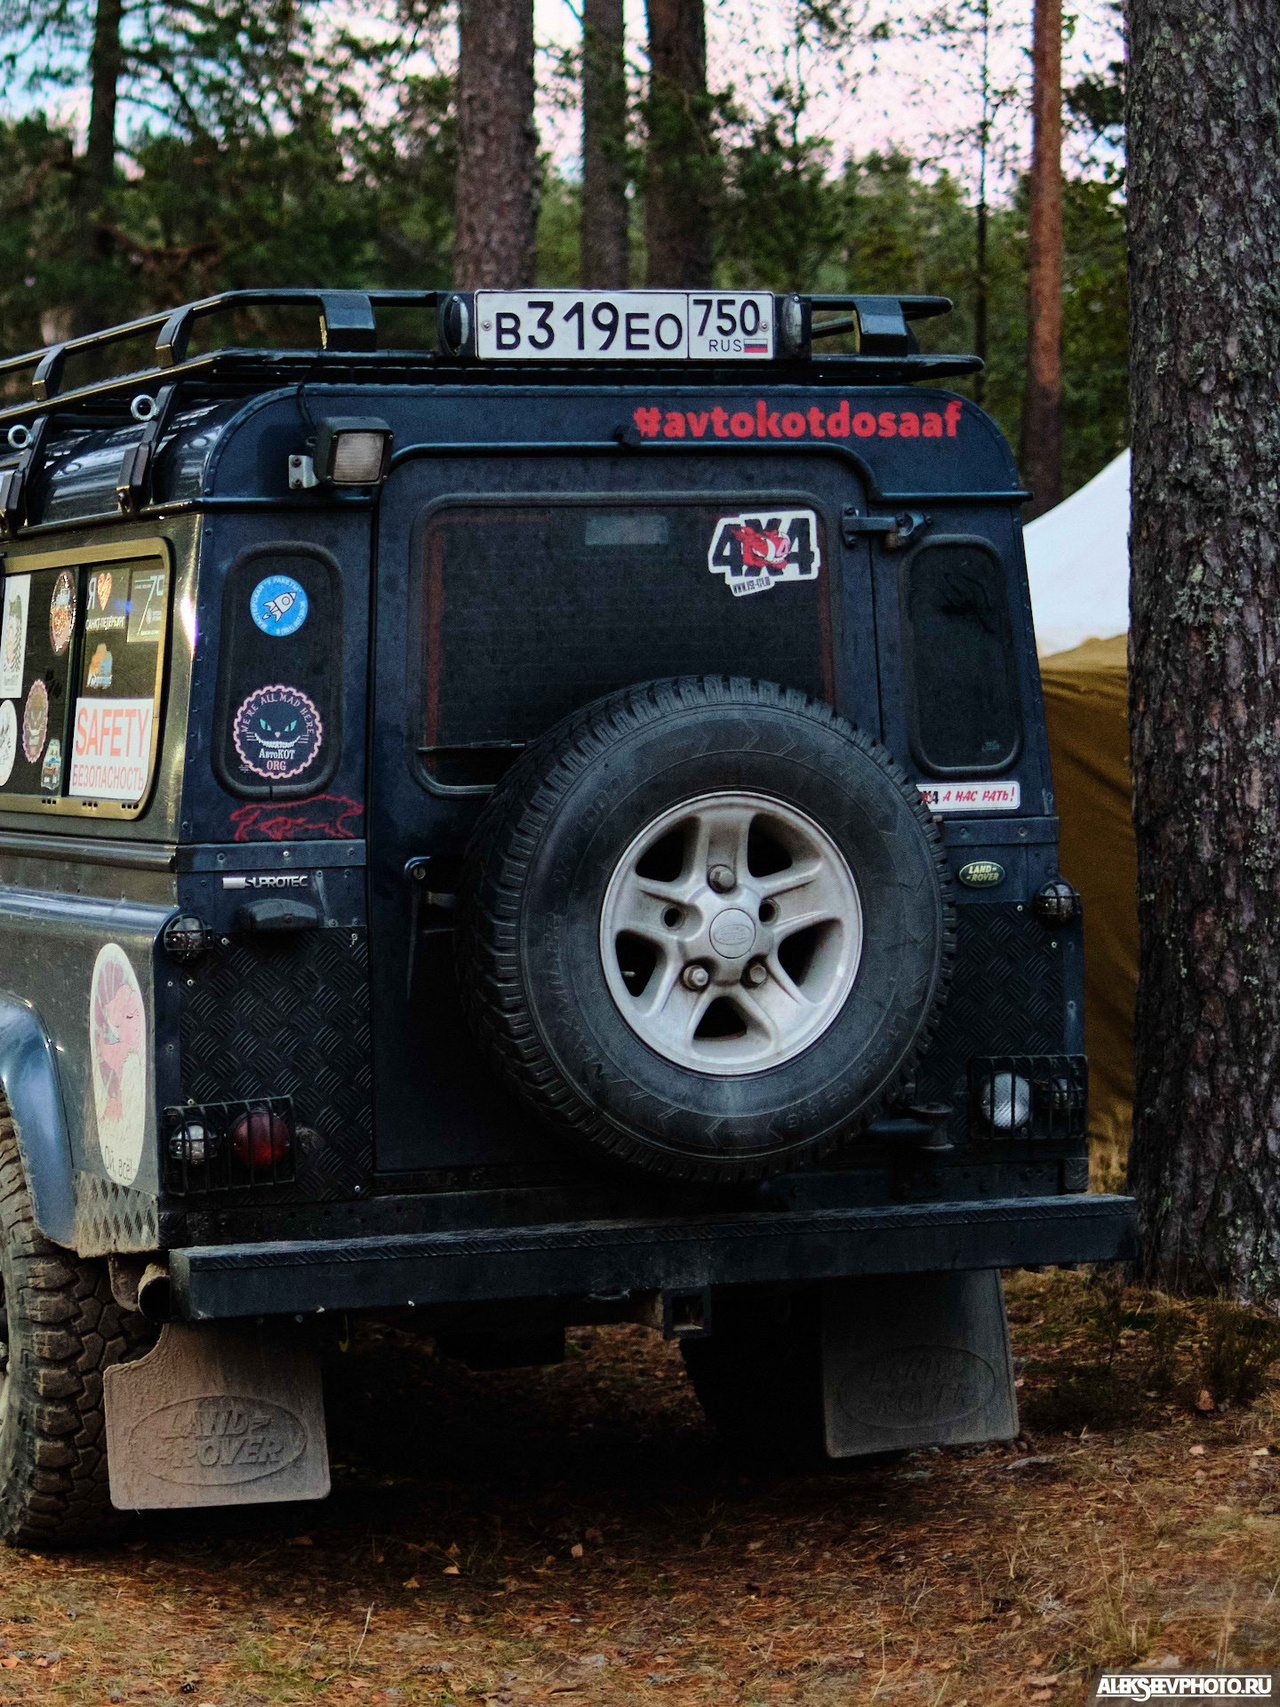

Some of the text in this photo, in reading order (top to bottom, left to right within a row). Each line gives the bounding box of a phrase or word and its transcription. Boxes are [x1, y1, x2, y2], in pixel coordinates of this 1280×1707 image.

[692, 298, 760, 338] 750
[708, 339, 743, 353] RUS
[632, 399, 964, 439] #avtokotdosaaf
[86, 576, 97, 611] Я
[259, 692, 278, 706] ALL
[279, 691, 301, 707] MAD
[299, 707, 315, 735] HERE
[75, 706, 150, 758] SAFETY
[71, 763, 145, 791] БЕЗОПАСНОСТЬ
[266, 760, 287, 771] ORG
[942, 790, 952, 802] А
[955, 789, 979, 802] НАС
[981, 786, 1016, 802] РАТЬ!
[245, 875, 308, 888] SUPROTEC
